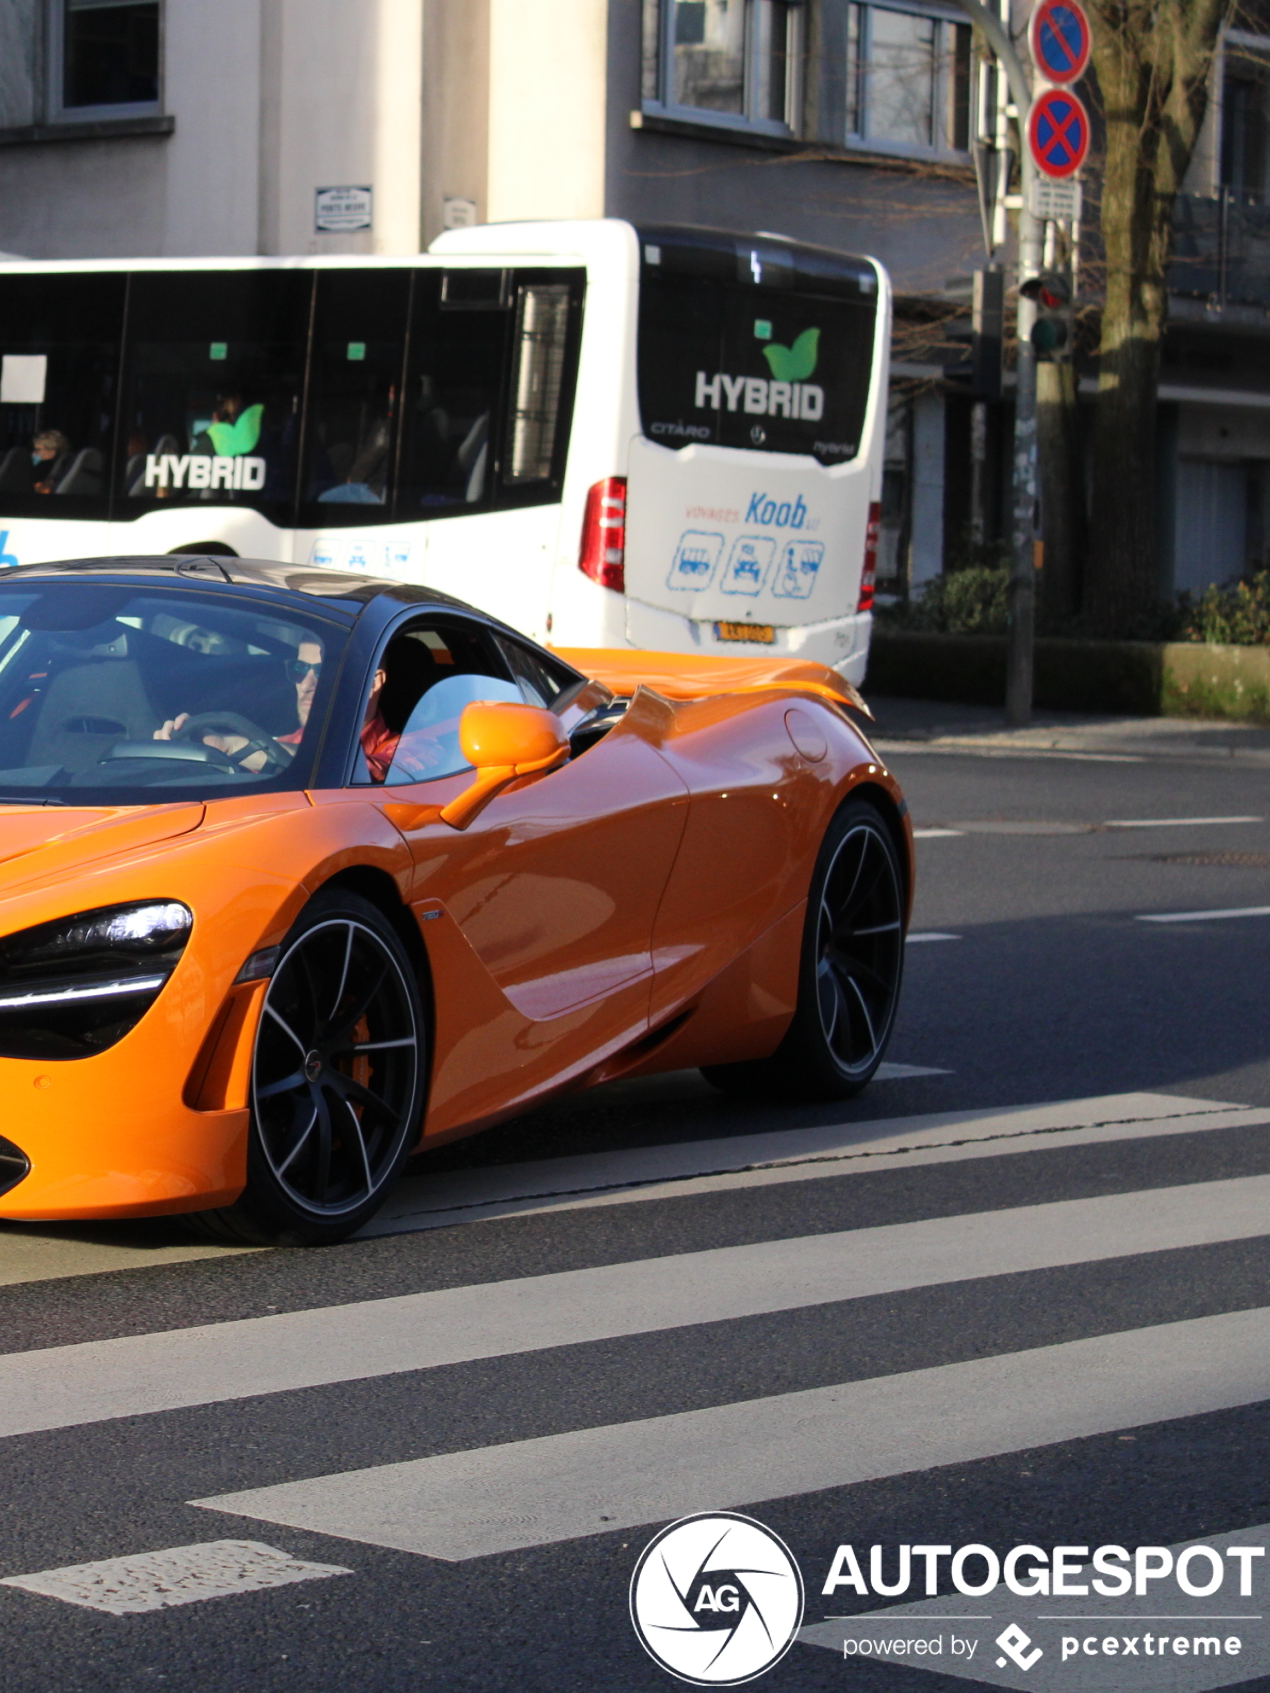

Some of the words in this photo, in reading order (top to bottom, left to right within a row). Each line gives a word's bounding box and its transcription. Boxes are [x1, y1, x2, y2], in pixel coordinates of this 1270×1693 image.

[695, 371, 824, 421] HYBRID
[651, 422, 710, 438] CITARO
[145, 454, 266, 490] HYBRID
